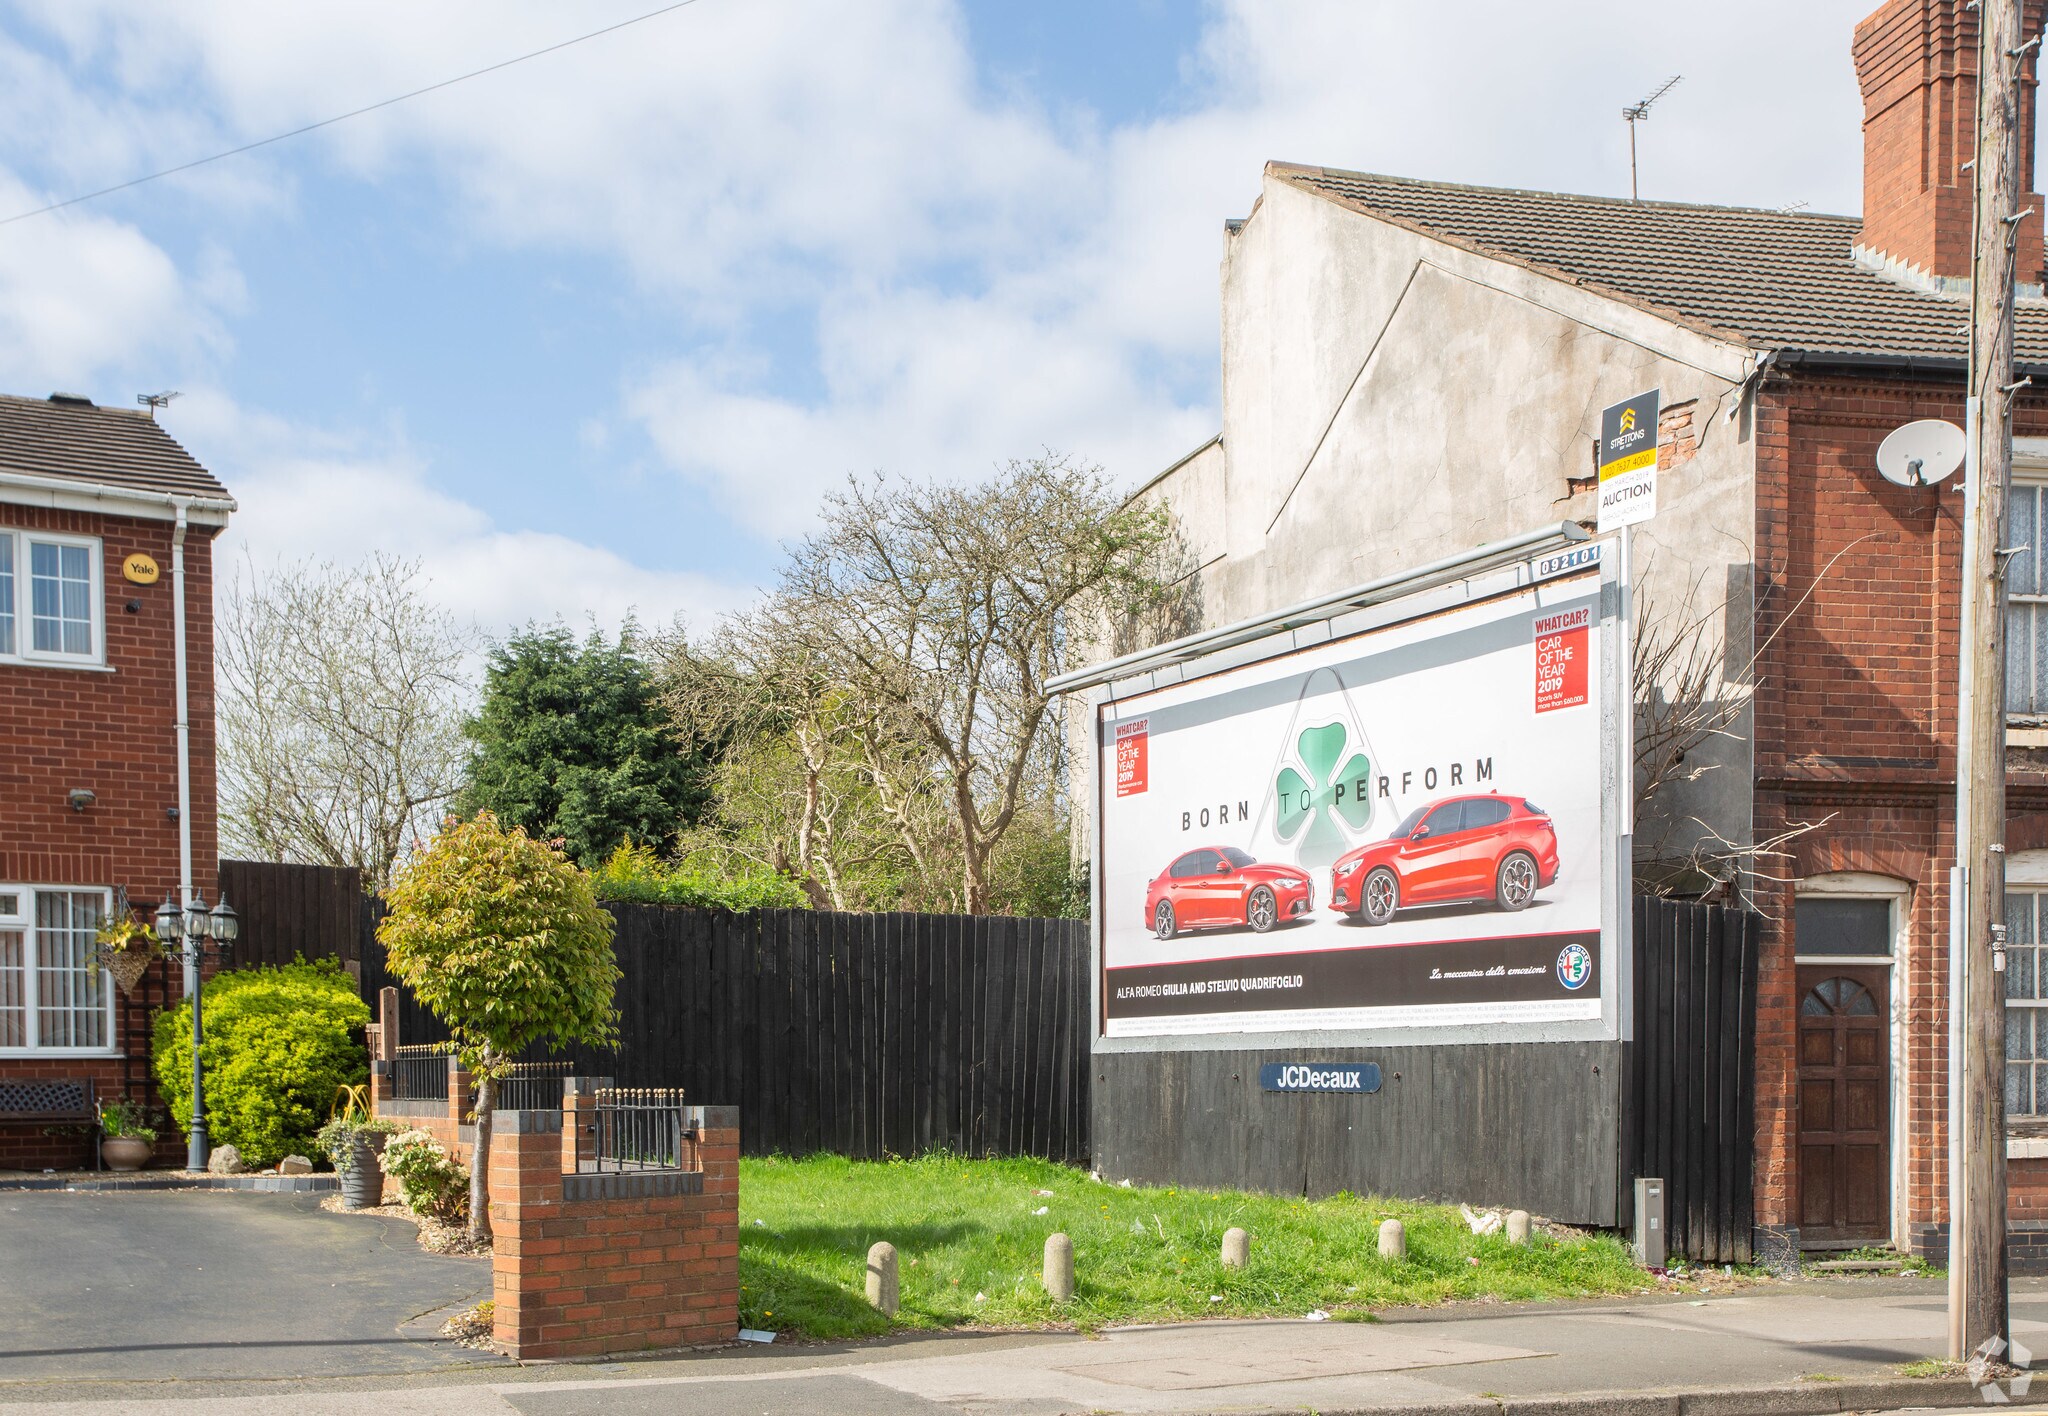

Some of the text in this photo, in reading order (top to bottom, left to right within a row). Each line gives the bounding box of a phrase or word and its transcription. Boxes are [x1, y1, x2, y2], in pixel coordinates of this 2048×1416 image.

[1610, 428, 1645, 450] STRETTONS
[1616, 459, 1631, 472] 7637
[1632, 454, 1650, 467] 4000
[1602, 481, 1652, 508] AUCTION
[1541, 546, 1599, 574] 092101
[131, 562, 154, 575] Yale
[1538, 636, 1562, 652] CAR
[1538, 646, 1573, 666] OF THE
[1538, 663, 1566, 679] YEAR
[1538, 677, 1563, 693] 2019
[1537, 691, 1564, 703] Sports SUV
[1537, 702, 1551, 710] more
[1118, 739, 1133, 751] CAR
[1118, 747, 1140, 762] OF THE
[1118, 759, 1136, 772] YEAR
[1118, 771, 1134, 783] 2019
[1182, 757, 1493, 831] BORN TO PERFORM
[1558, 946, 1591, 967] ALFA ROMEO
[1429, 964, 1547, 980] La meccanica delle emozioni
[1117, 974, 1303, 999] ALFA ROMEO GIULIA AND STELVIO QUADRIFOGLIO
[1277, 1065, 1361, 1089] JCDecaux
